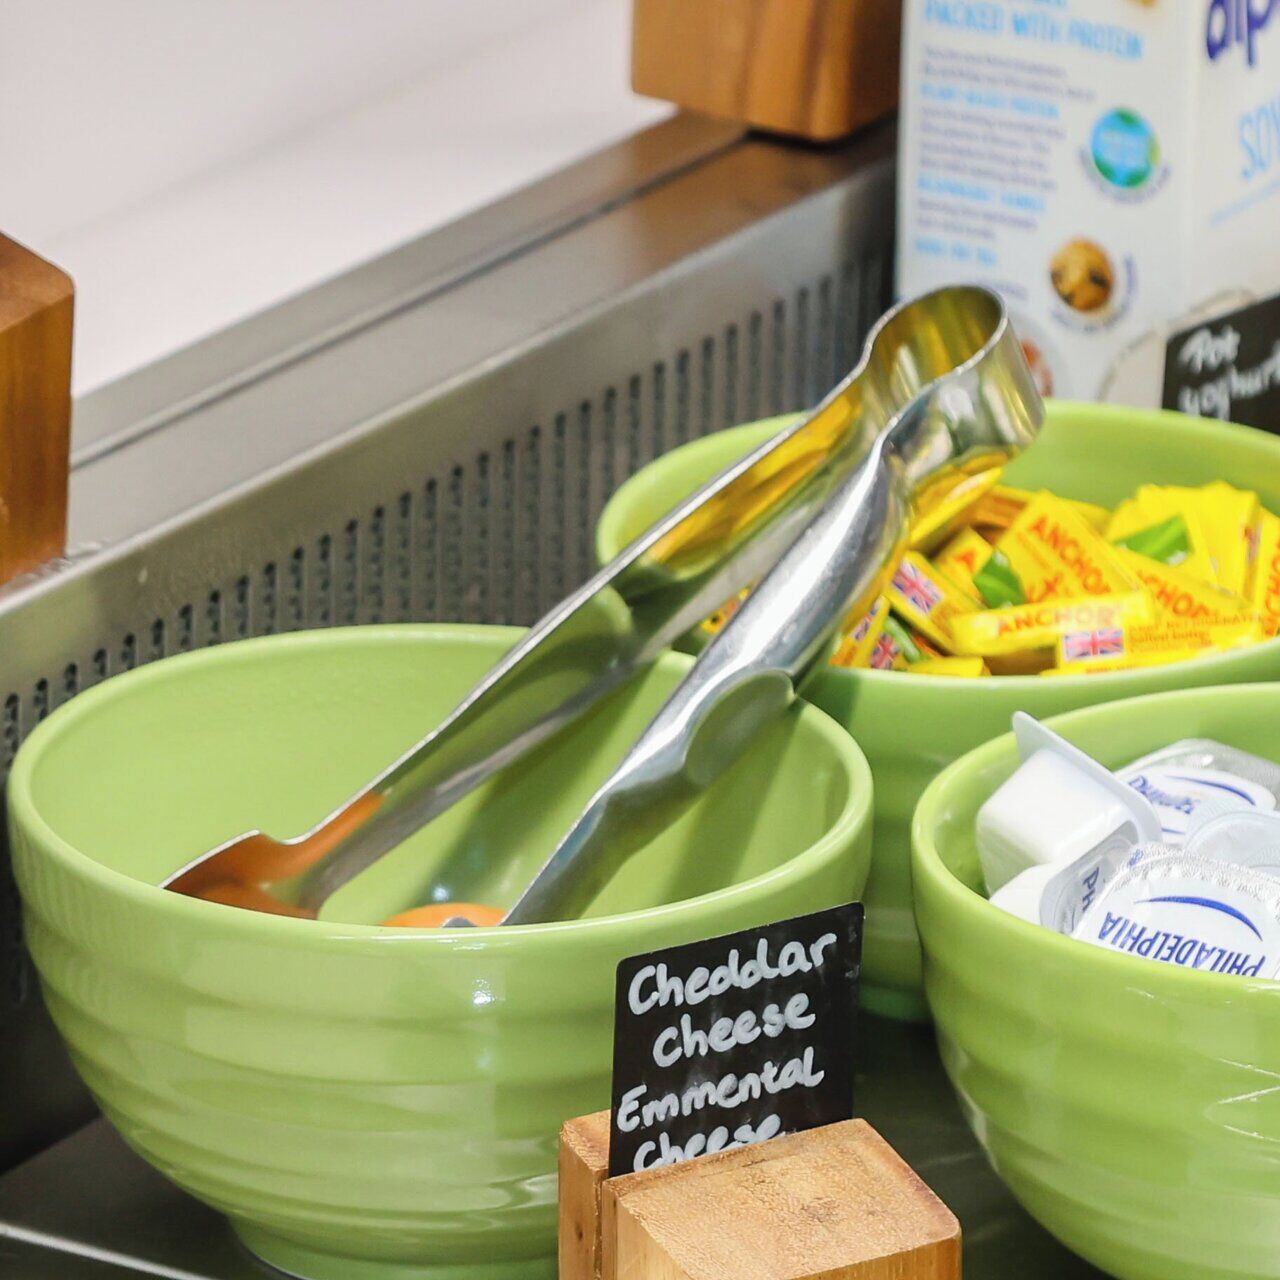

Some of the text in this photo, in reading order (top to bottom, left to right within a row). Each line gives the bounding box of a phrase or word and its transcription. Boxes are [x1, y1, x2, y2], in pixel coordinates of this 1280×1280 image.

[628, 932, 838, 1016] Cheddar
[652, 992, 817, 1068] Cheese
[616, 1046, 825, 1132] Emmental
